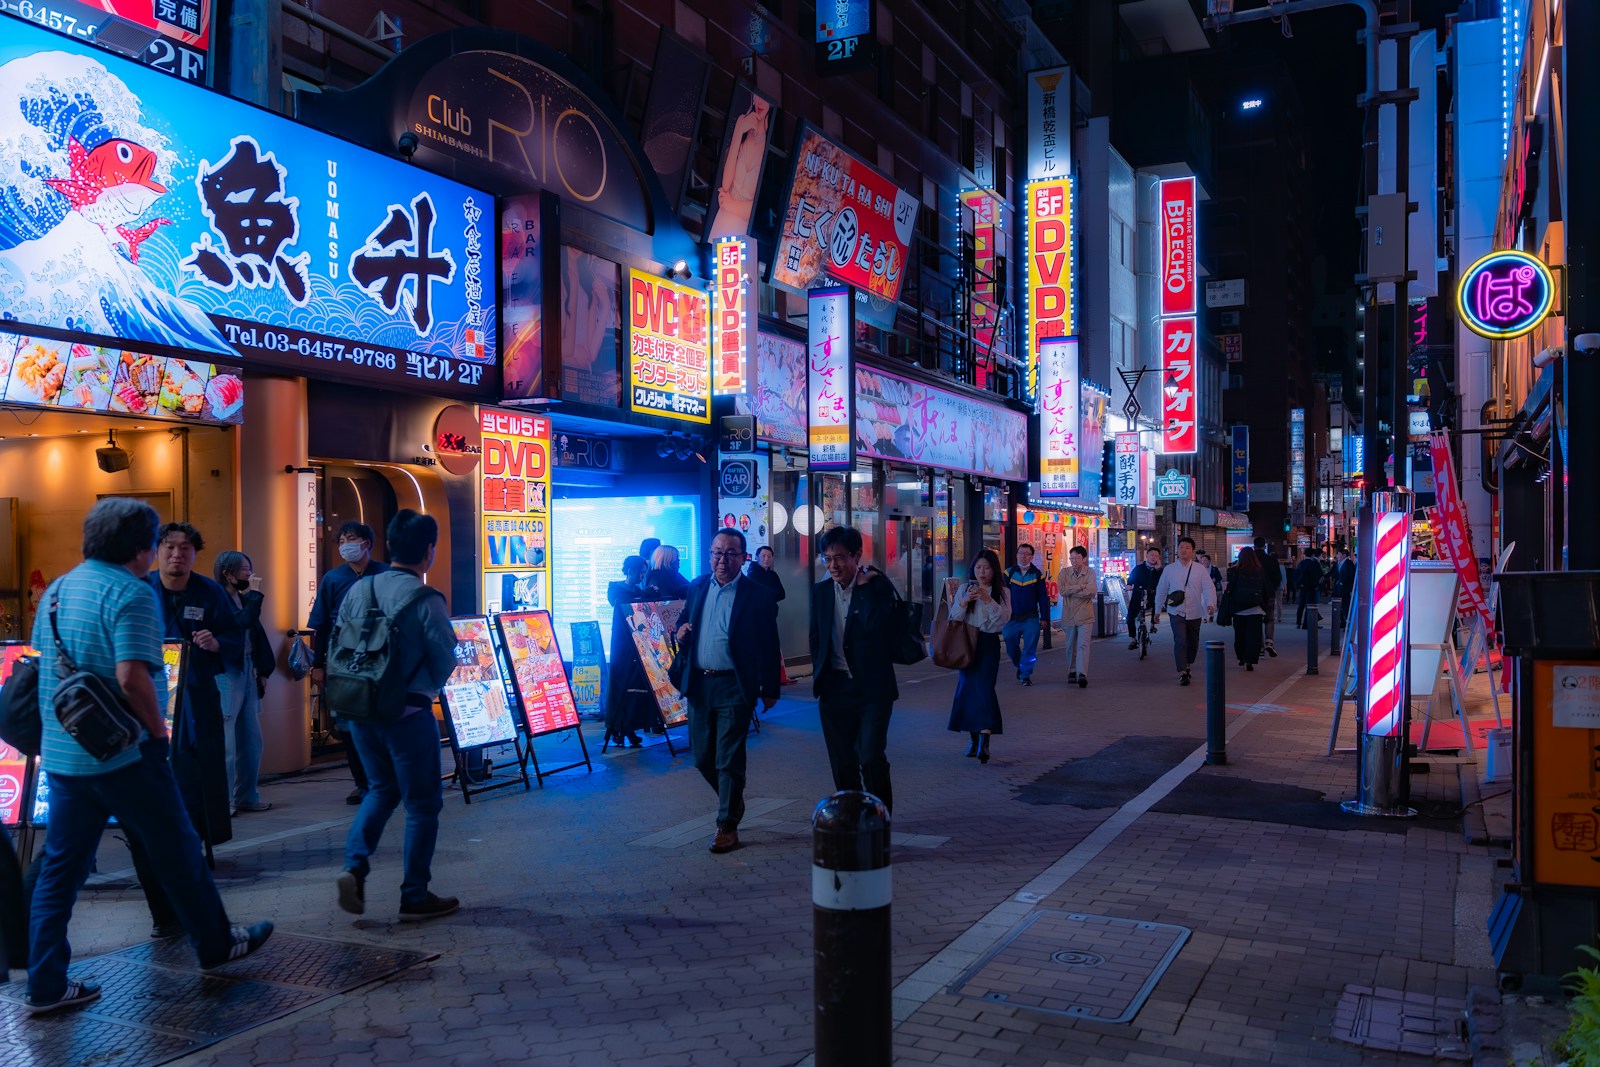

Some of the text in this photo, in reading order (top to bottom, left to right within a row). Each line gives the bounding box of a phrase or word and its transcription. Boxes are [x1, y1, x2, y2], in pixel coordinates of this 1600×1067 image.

[158, 4, 198, 30] 完備
[150, 38, 204, 79] 2F
[827, 37, 859, 61] 2F
[427, 94, 472, 136] Club
[1042, 92, 1056, 173] 新橋乾杯ビル
[415, 123, 484, 158] SHIMBASHI
[488, 67, 607, 201] RIO
[805, 150, 893, 219] NI KU TA RA SHI
[325, 159, 339, 280] UOMASU
[897, 200, 913, 226] 2F
[1037, 196, 1061, 216] 5F
[525, 220, 535, 257] BAR
[1166, 200, 1185, 293] BIG ECHO
[722, 253, 738, 265] 5F
[511, 222, 519, 361] RAFTEL
[1477, 265, 1536, 320] ぱ
[721, 267, 740, 375] DVD鑑賞
[225, 324, 484, 387] Tel.03-6457-9786 当ビル 2F
[633, 332, 706, 370] カギ付完全個室
[507, 380, 523, 390] 1F
[633, 360, 707, 393] インターネット
[811, 334, 847, 424] すしざんまい
[1166, 330, 1194, 441] カラオケ
[482, 413, 545, 437] 当ビル5F
[730, 428, 751, 441] RIO
[1043, 378, 1077, 457] すしざんまい
[484, 437, 546, 478] DVD
[577, 438, 609, 467] RIO
[730, 441, 742, 450] 3F
[811, 453, 847, 462] SL広場前店
[823, 444, 836, 452] 新橋
[724, 474, 748, 485] BAR
[1042, 481, 1077, 489] SL広場前店
[1118, 454, 1137, 501] 酔っ手羽
[1234, 448, 1246, 493] セキネ
[484, 477, 525, 512] 鑑賞
[518, 520, 543, 532] 4KSD
[308, 482, 316, 617] RAFTEL BA
[487, 535, 527, 566] VR
